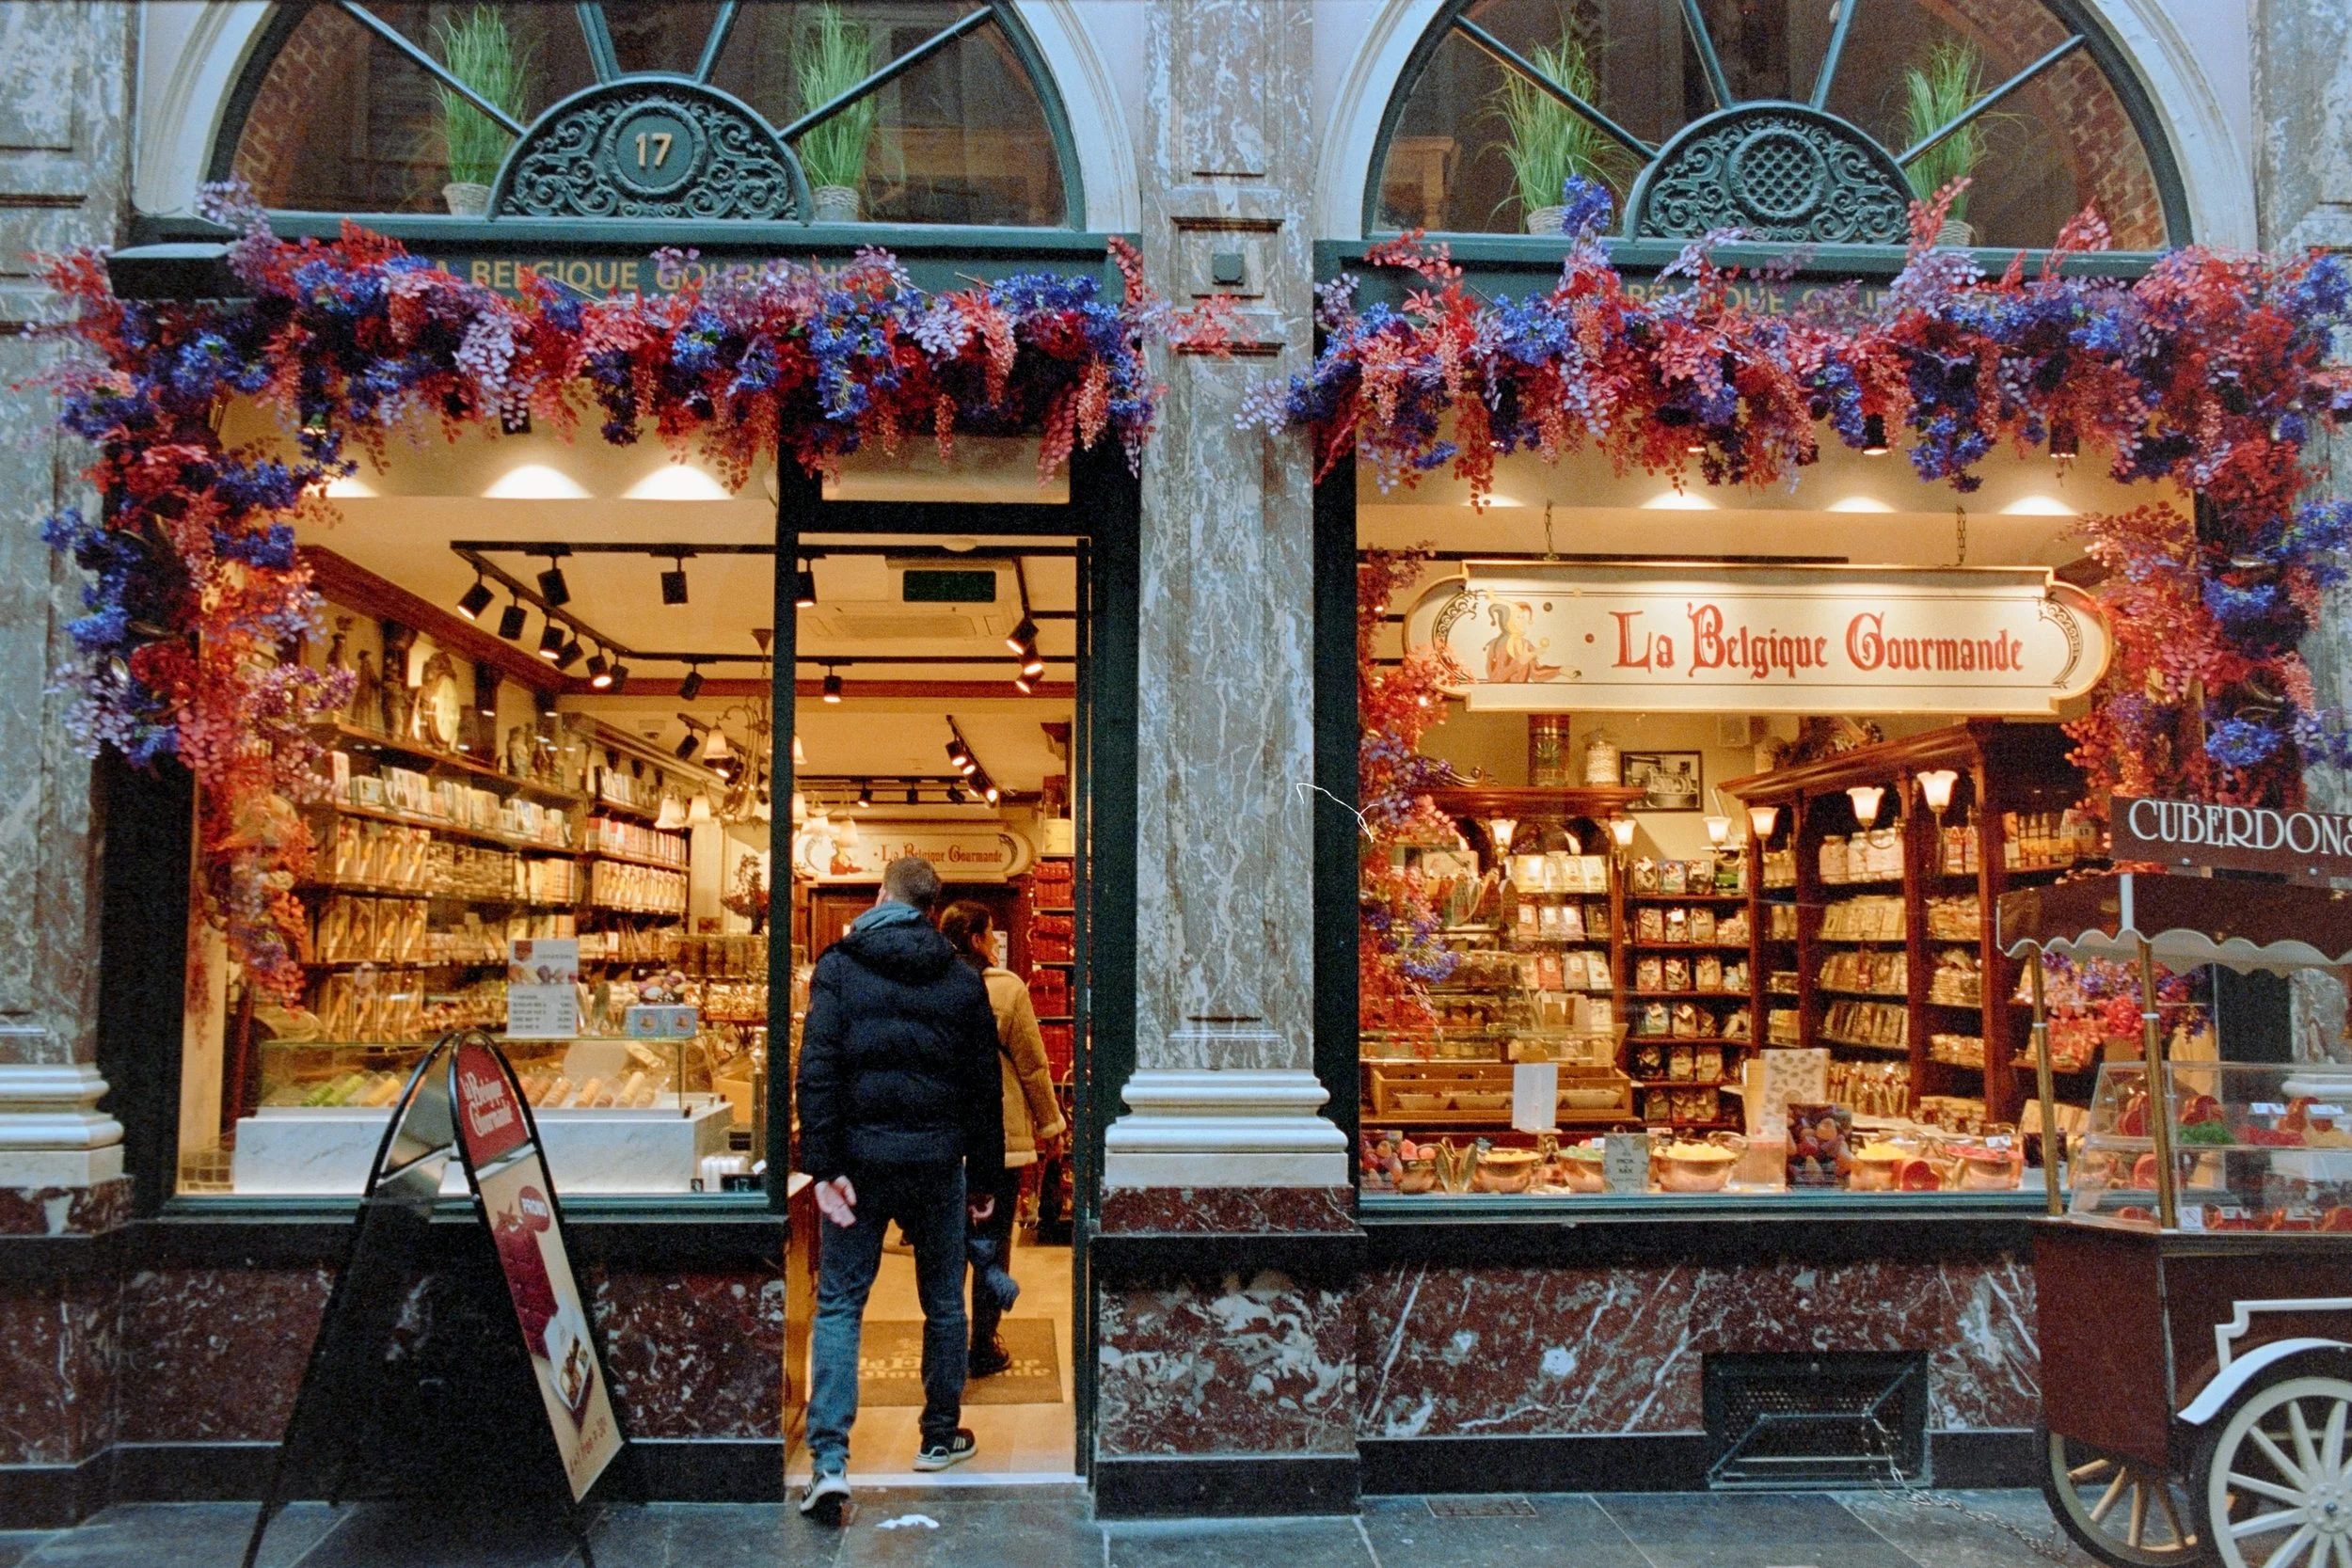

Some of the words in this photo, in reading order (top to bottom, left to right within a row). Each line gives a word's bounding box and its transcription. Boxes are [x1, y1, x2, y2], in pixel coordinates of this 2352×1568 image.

[635, 132, 674, 167] 17
[1609, 610, 1675, 673] La
[1687, 602, 1828, 679] Belgique
[1845, 610, 2024, 672] Gourmande
[947, 844, 1003, 863] Gourmande
